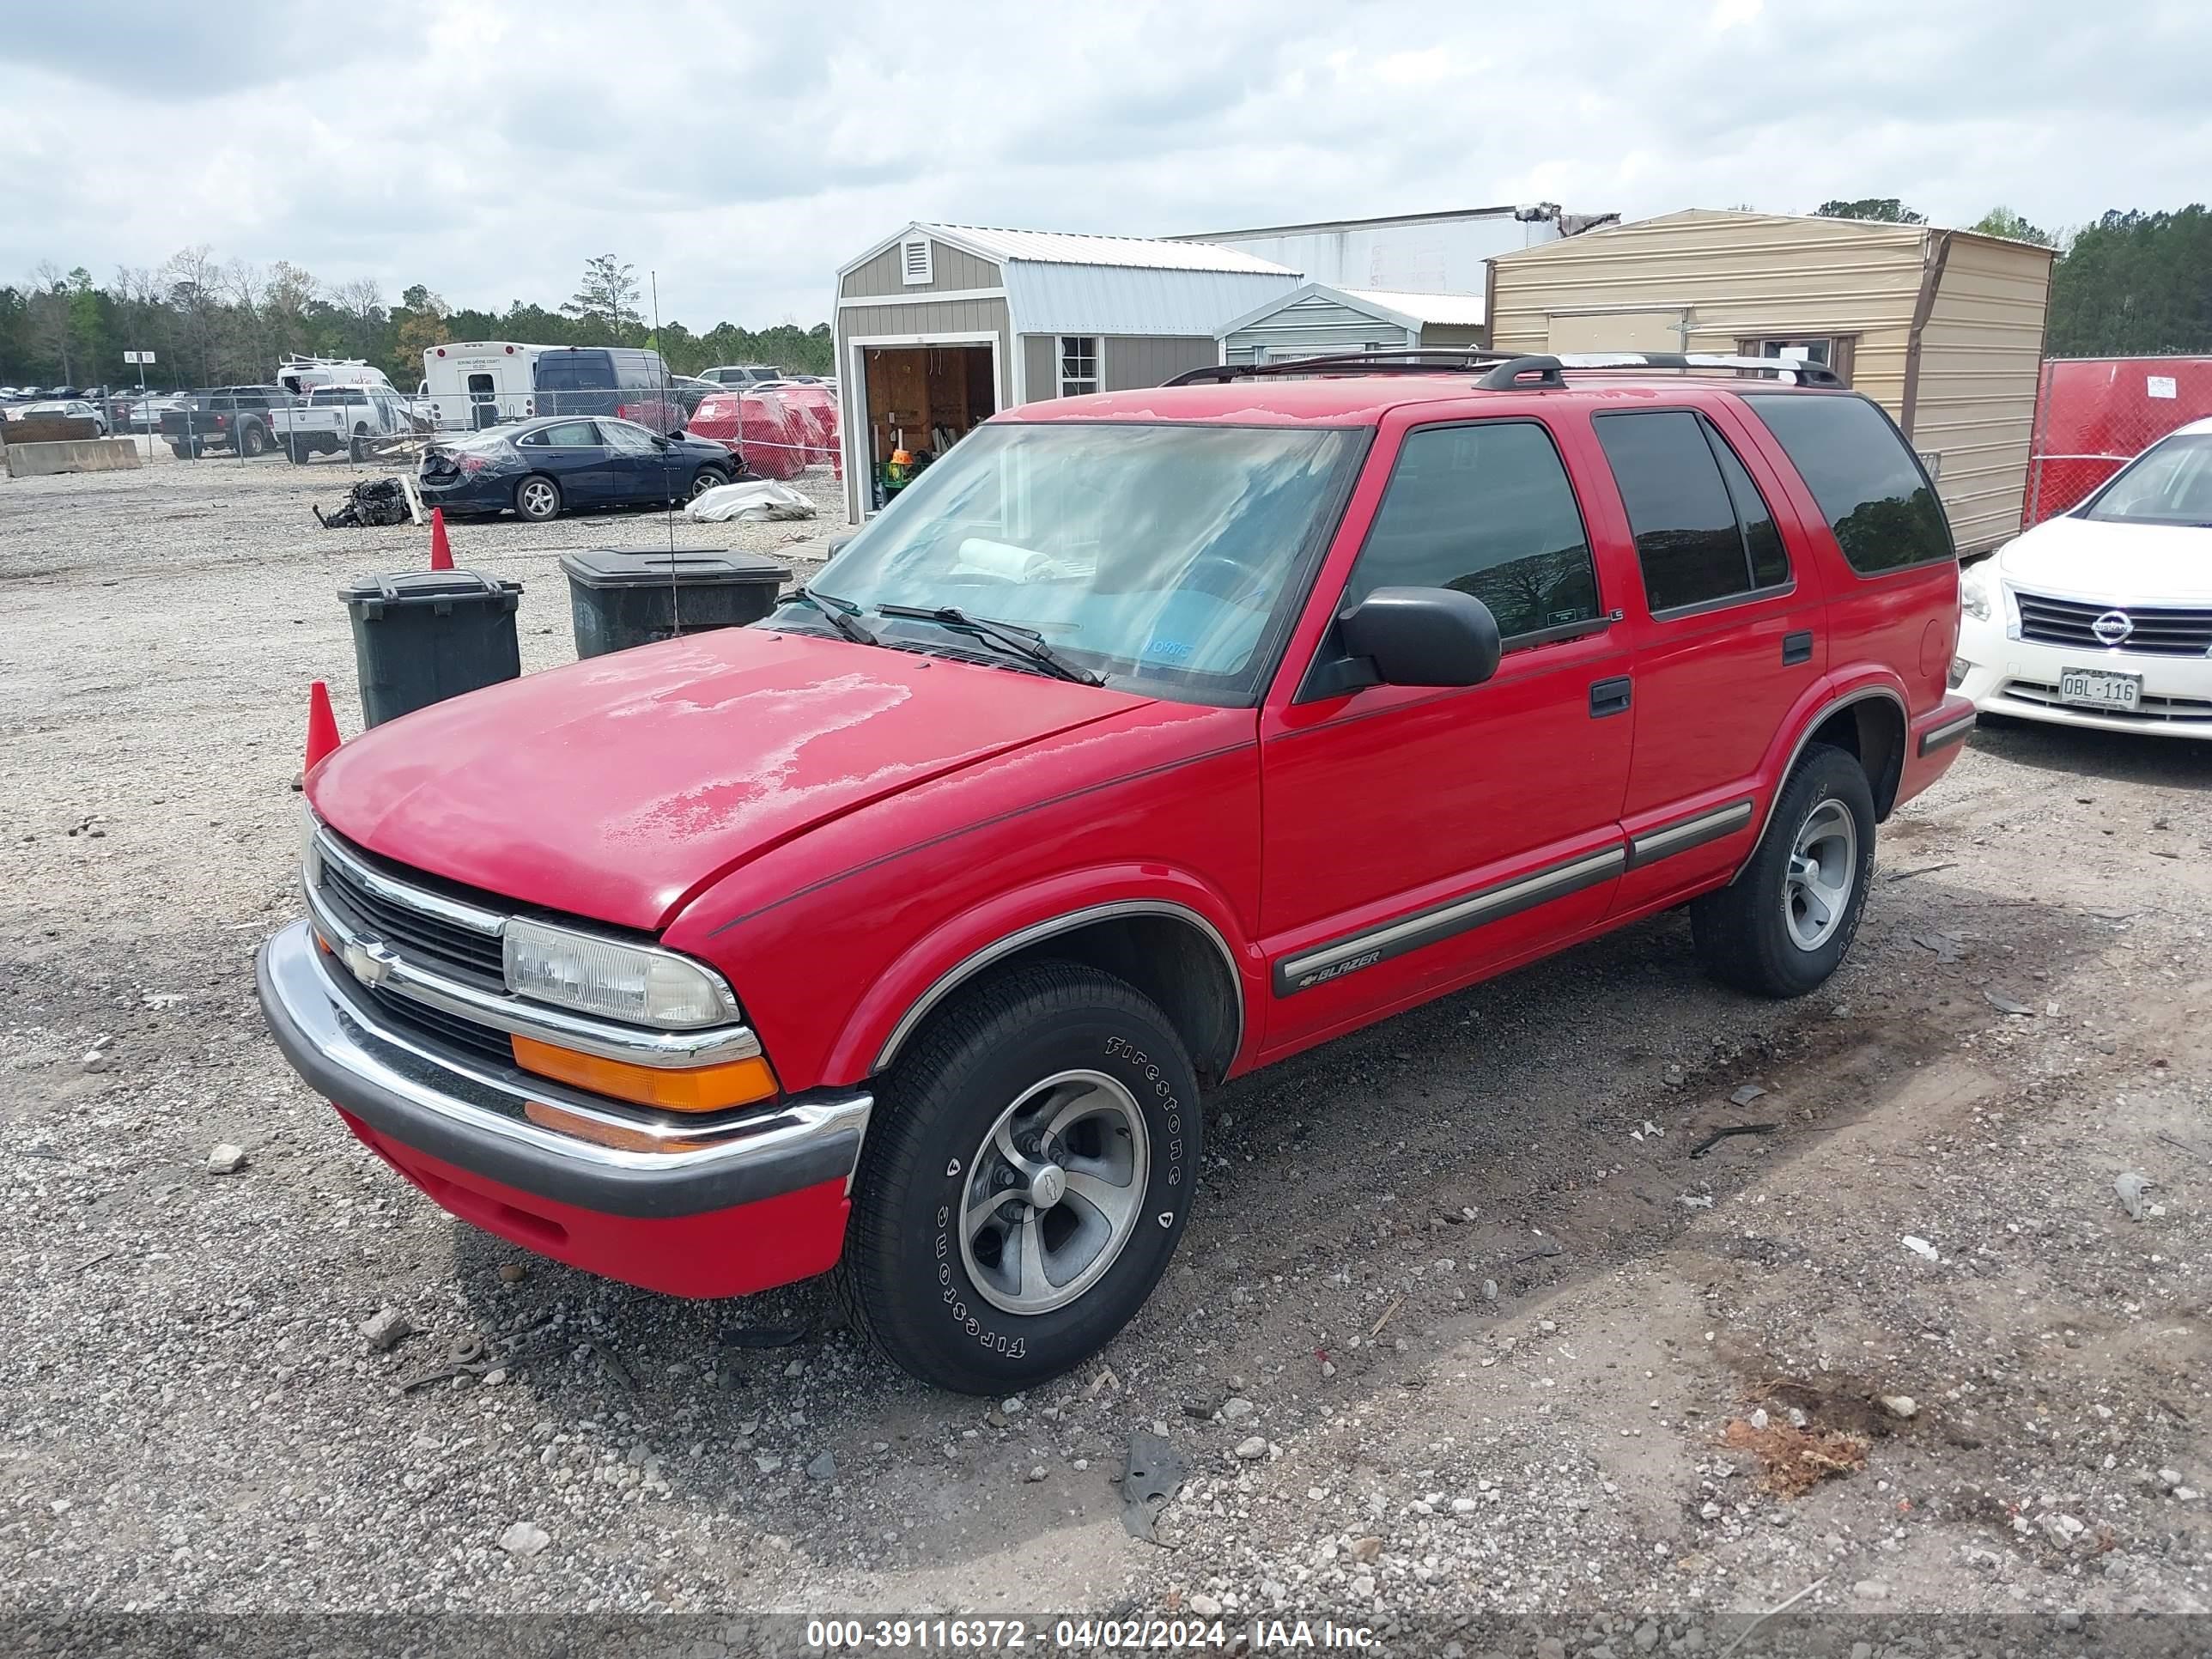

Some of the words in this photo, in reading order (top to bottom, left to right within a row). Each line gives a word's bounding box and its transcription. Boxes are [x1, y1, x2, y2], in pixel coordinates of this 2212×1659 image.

[127, 353, 136, 362] A
[144, 353, 153, 362] B
[2095, 623, 2129, 633] NISSAN
[1316, 950, 1382, 982] BLAZER
[1104, 1036, 1182, 1187] Firestone
[935, 1205, 1026, 1359] Firestone
